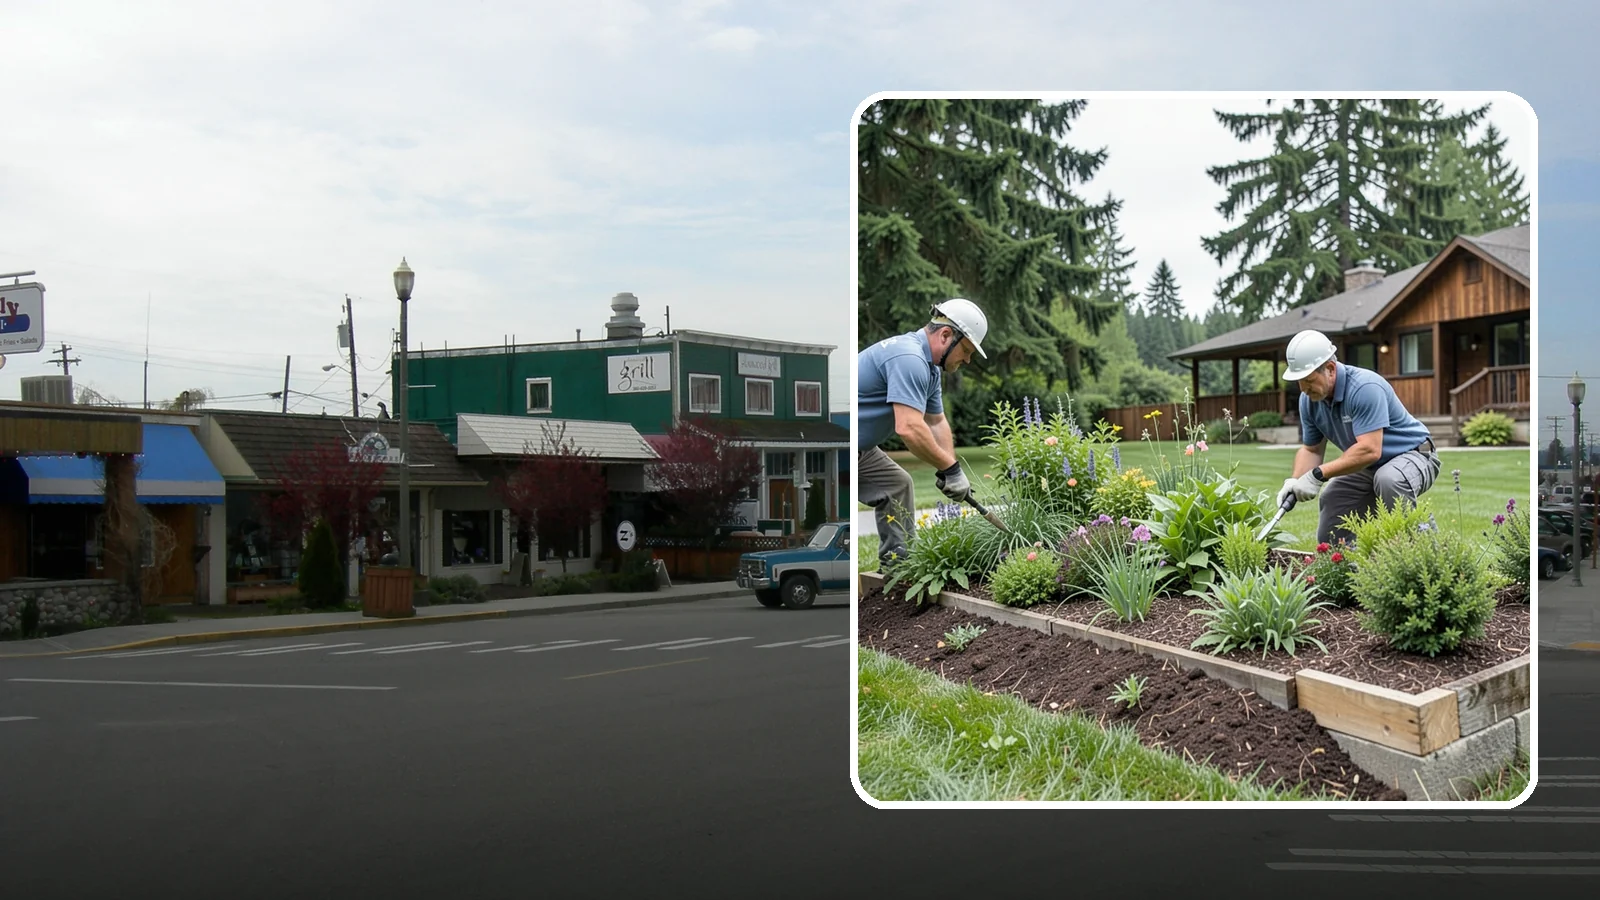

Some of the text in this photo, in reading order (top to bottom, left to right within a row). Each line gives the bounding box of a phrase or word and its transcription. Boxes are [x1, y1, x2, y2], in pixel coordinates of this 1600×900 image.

[3, 338, 16, 346] Fries
[20, 336, 38, 345] Salads
[617, 356, 654, 391] grill
